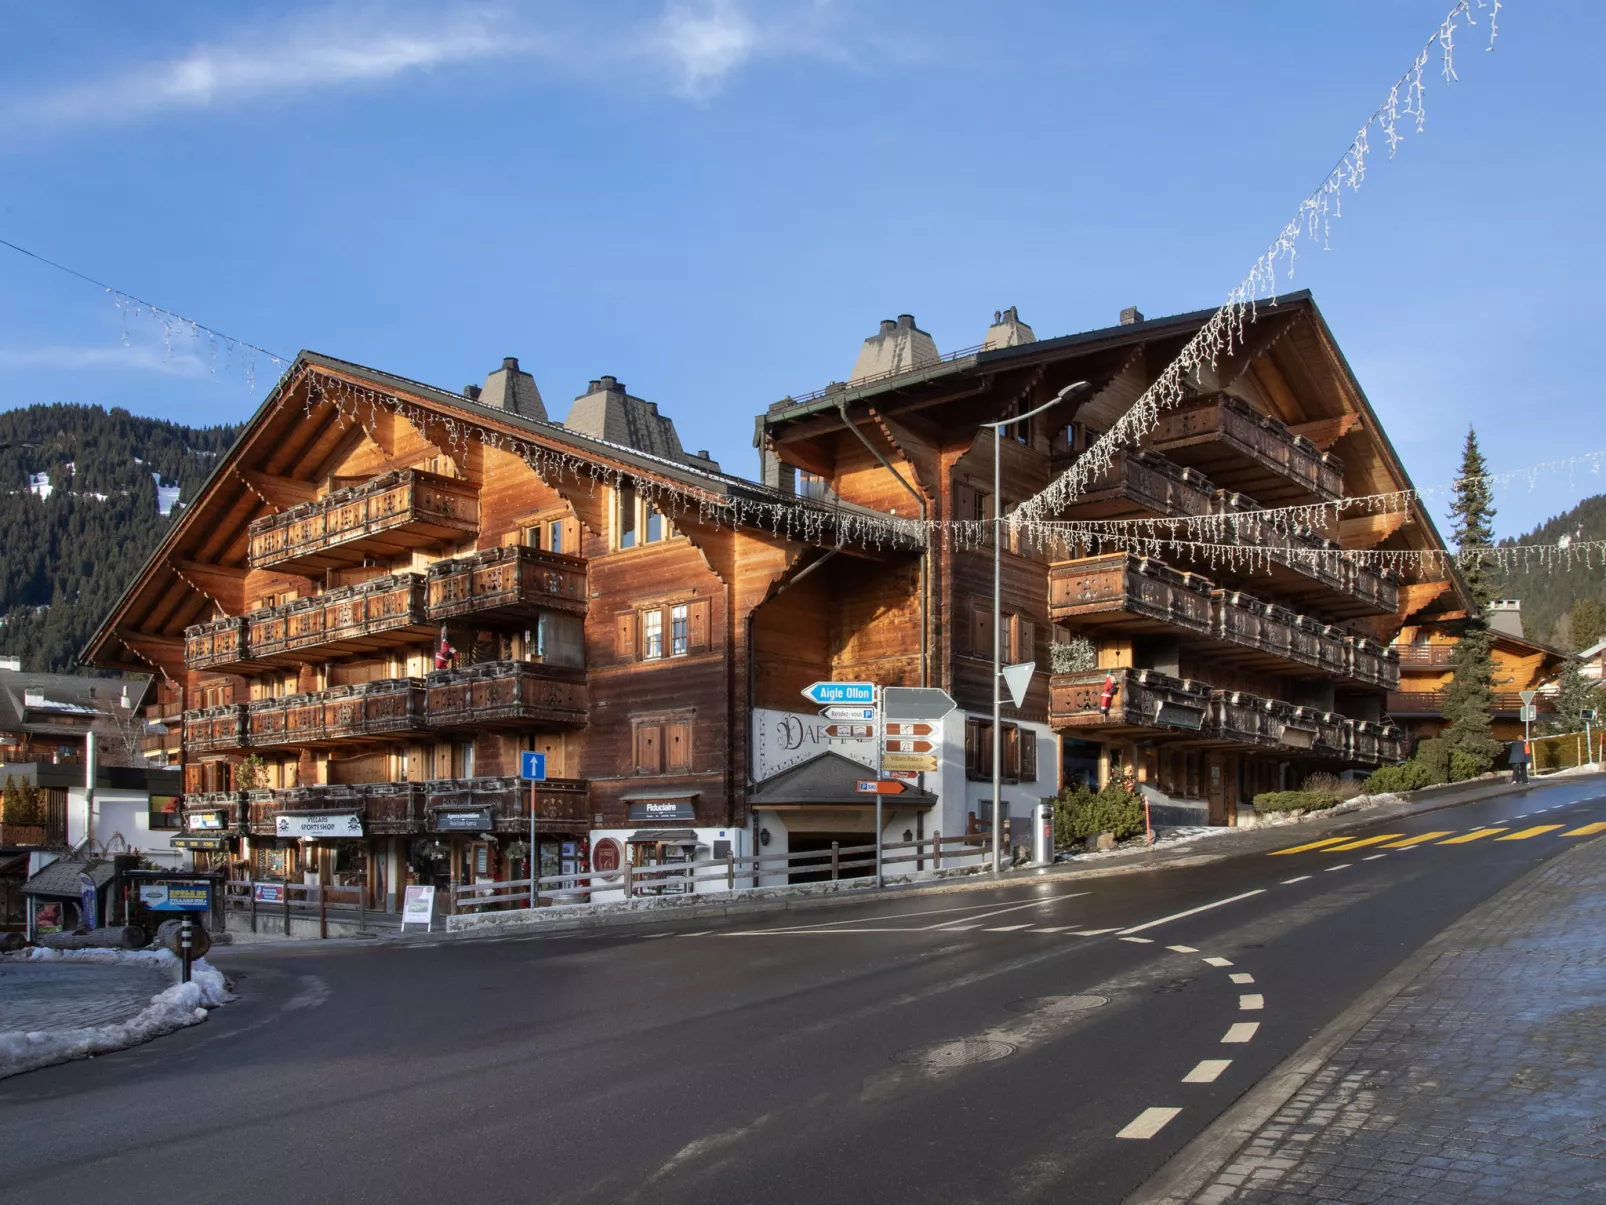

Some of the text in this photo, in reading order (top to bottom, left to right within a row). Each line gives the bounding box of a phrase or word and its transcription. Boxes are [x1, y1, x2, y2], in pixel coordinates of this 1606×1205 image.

[820, 687, 869, 700] Aigle Ollon
[646, 803, 677, 811] Fiduciaire
[301, 823, 335, 831] SPORTS SHOP
